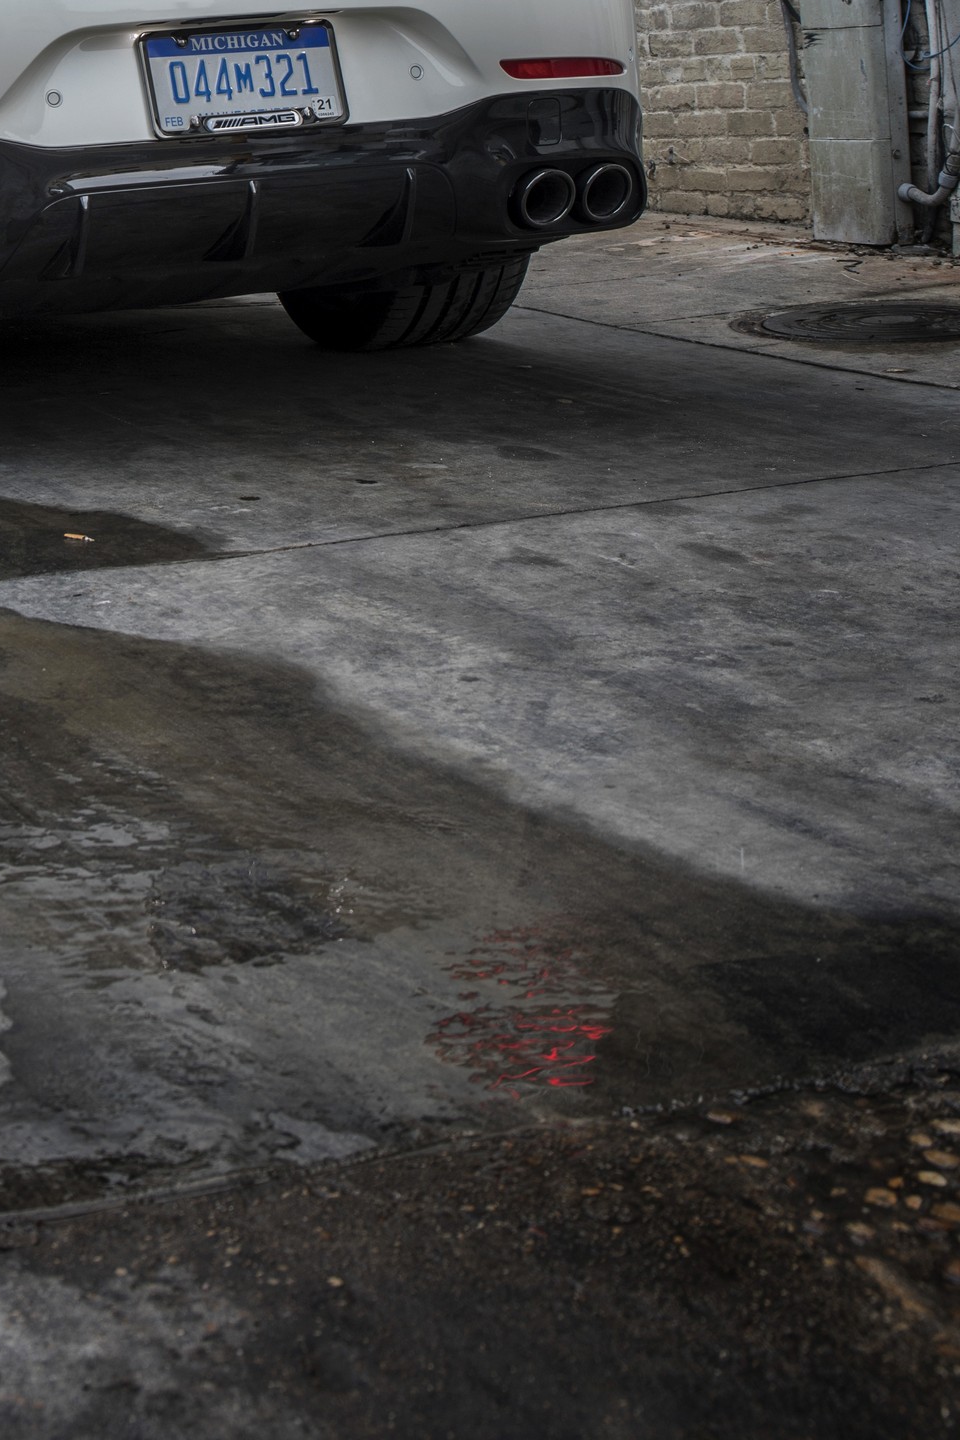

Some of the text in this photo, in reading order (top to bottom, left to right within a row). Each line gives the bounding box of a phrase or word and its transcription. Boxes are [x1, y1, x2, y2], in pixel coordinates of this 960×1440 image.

[191, 32, 283, 51] MICHIGAN
[169, 51, 319, 104] 044M321
[317, 98, 332, 110] 21
[165, 116, 184, 127] FEB
[239, 113, 295, 126] AMG
